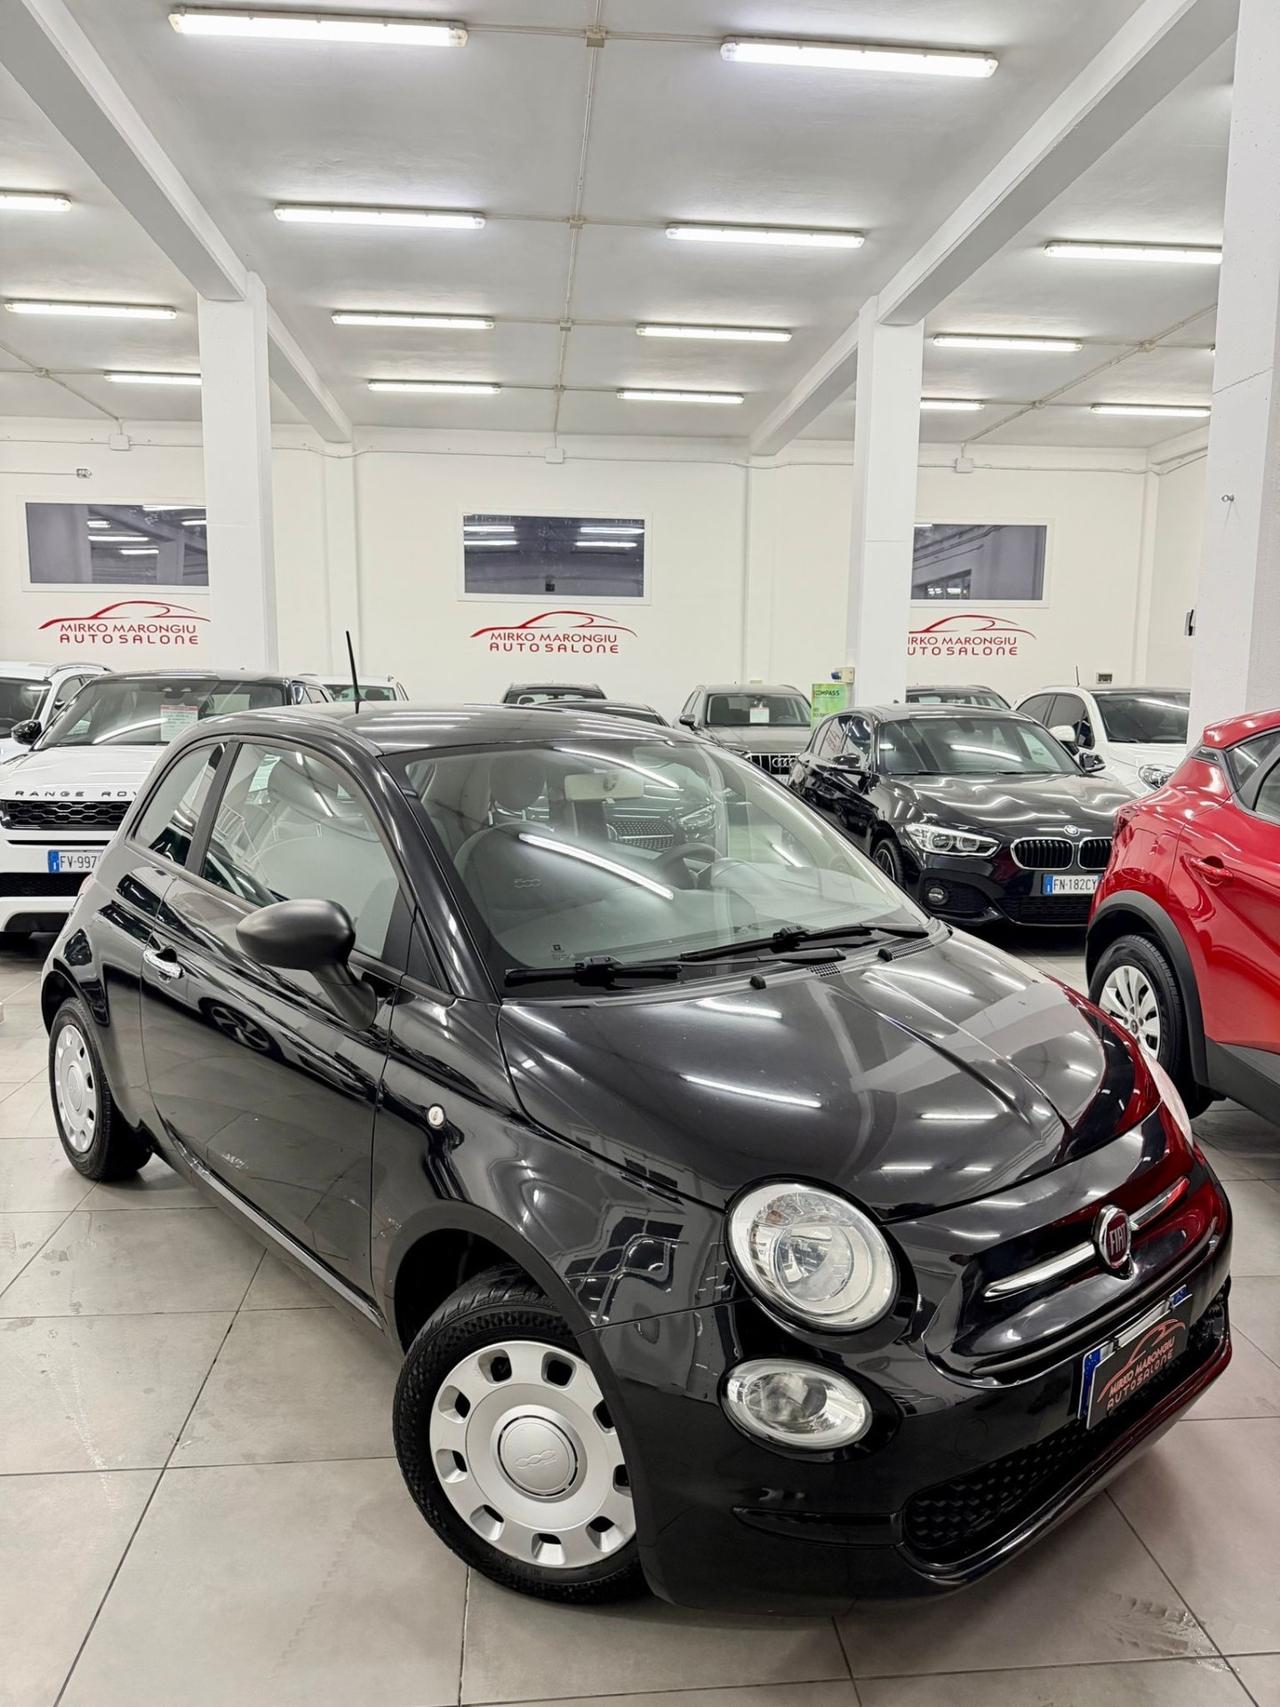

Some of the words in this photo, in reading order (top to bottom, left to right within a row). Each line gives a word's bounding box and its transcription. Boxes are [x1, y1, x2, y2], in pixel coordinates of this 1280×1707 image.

[60, 623, 108, 633] MIRKO
[112, 624, 196, 634] MARONGIU
[60, 633, 199, 645] AUTOSALONE
[490, 632, 535, 642] MIRKO
[539, 633, 617, 643] MARONGIU
[907, 636, 938, 645] IRKO
[941, 636, 1017, 646] MARONGIU
[489, 642, 619, 654] AUTOSALONE
[907, 646, 1018, 656] UTOSALONE
[1109, 1222, 1126, 1256] FIAT
